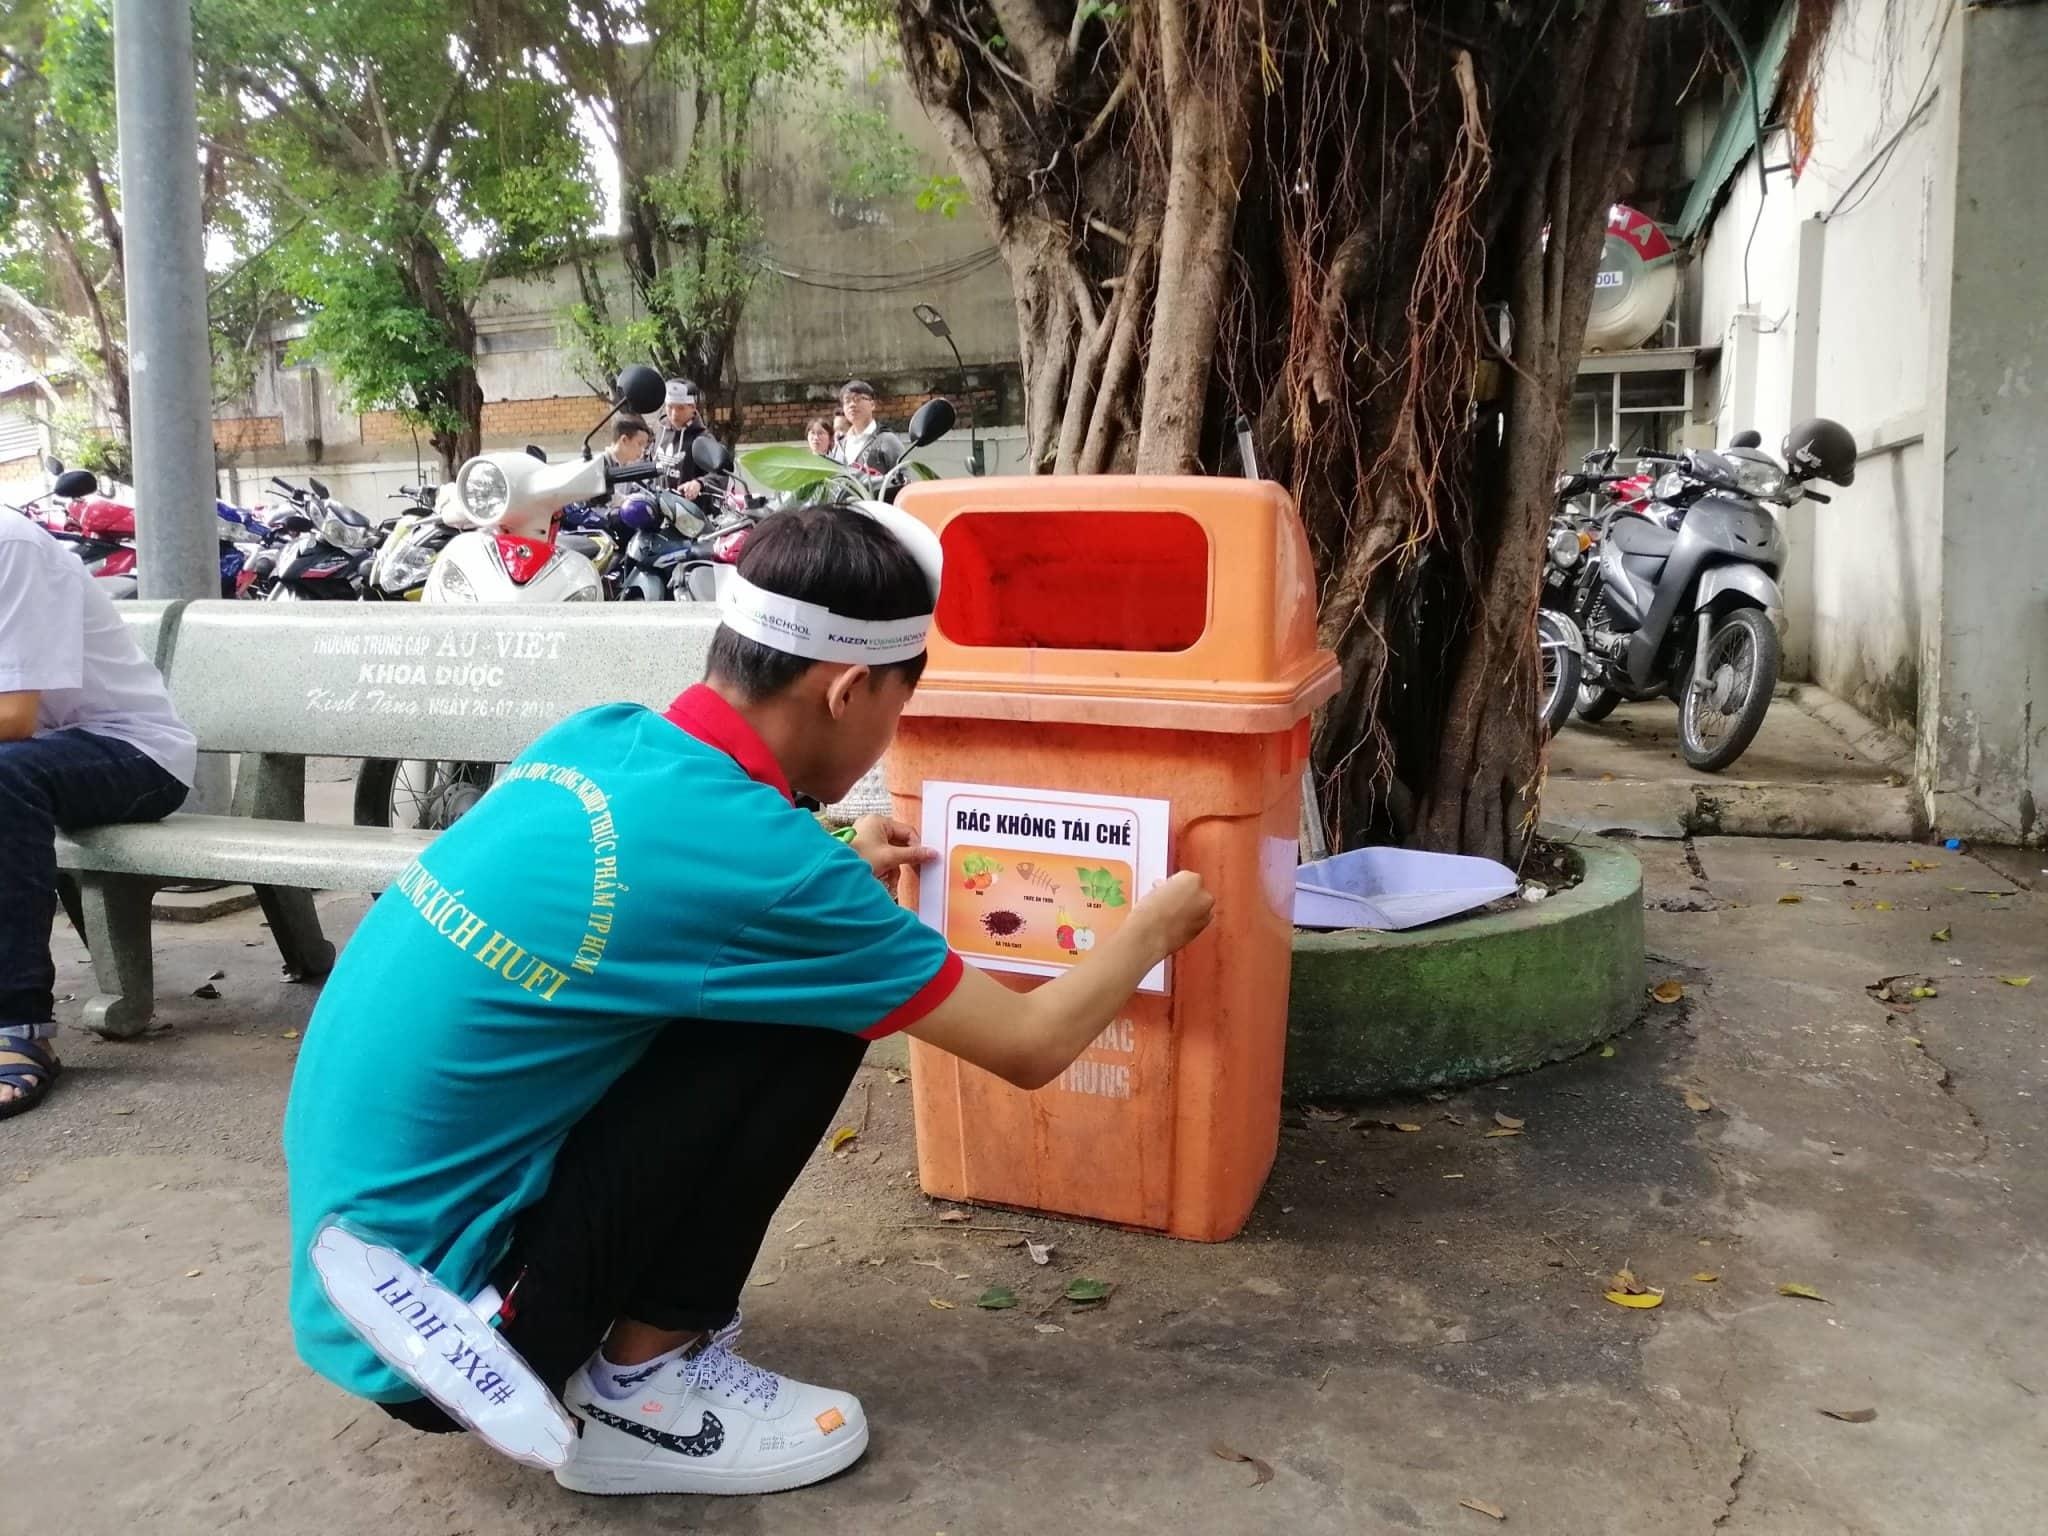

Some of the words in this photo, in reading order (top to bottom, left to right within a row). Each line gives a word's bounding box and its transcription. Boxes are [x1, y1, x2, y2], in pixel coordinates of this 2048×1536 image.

[362, 634, 402, 656] TRUNG
[496, 624, 566, 665] VIỆT
[359, 664, 427, 685] KHOA
[435, 661, 504, 693] DƯỢC
[588, 810, 620, 855] THỰC
[956, 808, 990, 833] RÁC
[996, 813, 1056, 839] KHÔNG
[1062, 818, 1090, 842] TÁI
[1096, 819, 1131, 846] CHẾ
[591, 856, 629, 907] PHẨM
[420, 887, 488, 951] KÍCH
[473, 930, 570, 1001] HUFI
[588, 913, 613, 937] TP
[571, 934, 607, 975] HCM
